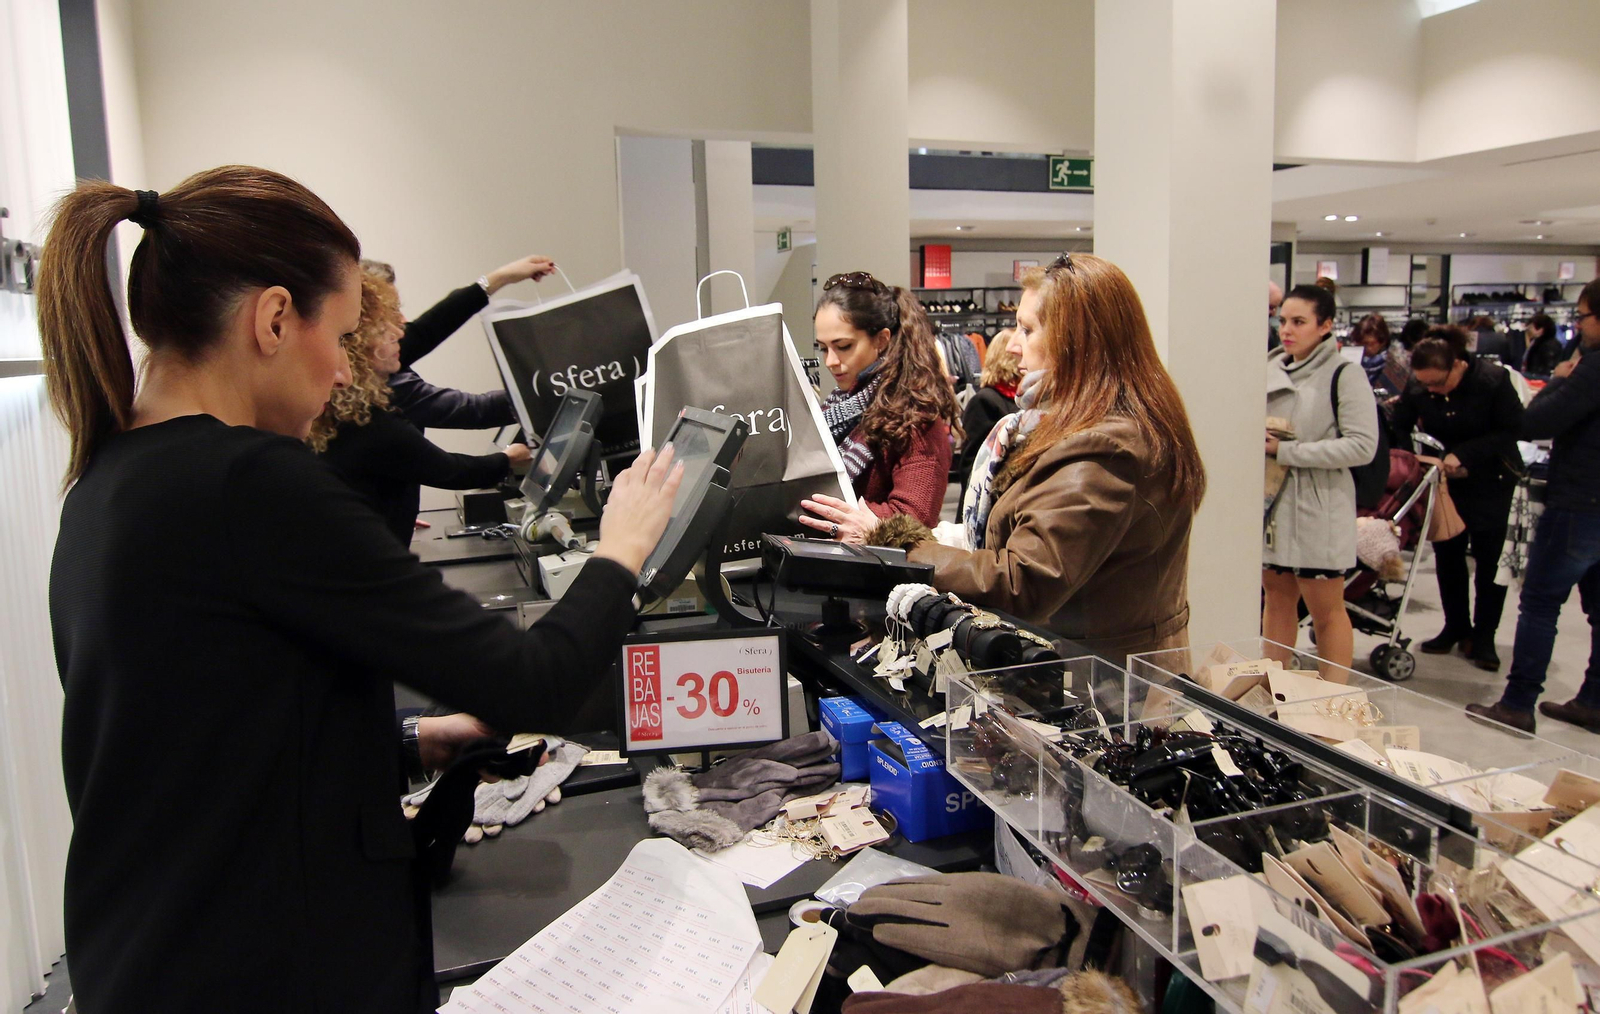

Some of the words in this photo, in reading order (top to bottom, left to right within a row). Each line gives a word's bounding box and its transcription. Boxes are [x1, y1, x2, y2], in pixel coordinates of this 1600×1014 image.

[632, 651, 655, 677] RE
[633, 677, 656, 702] BA
[631, 702, 661, 729] JAS
